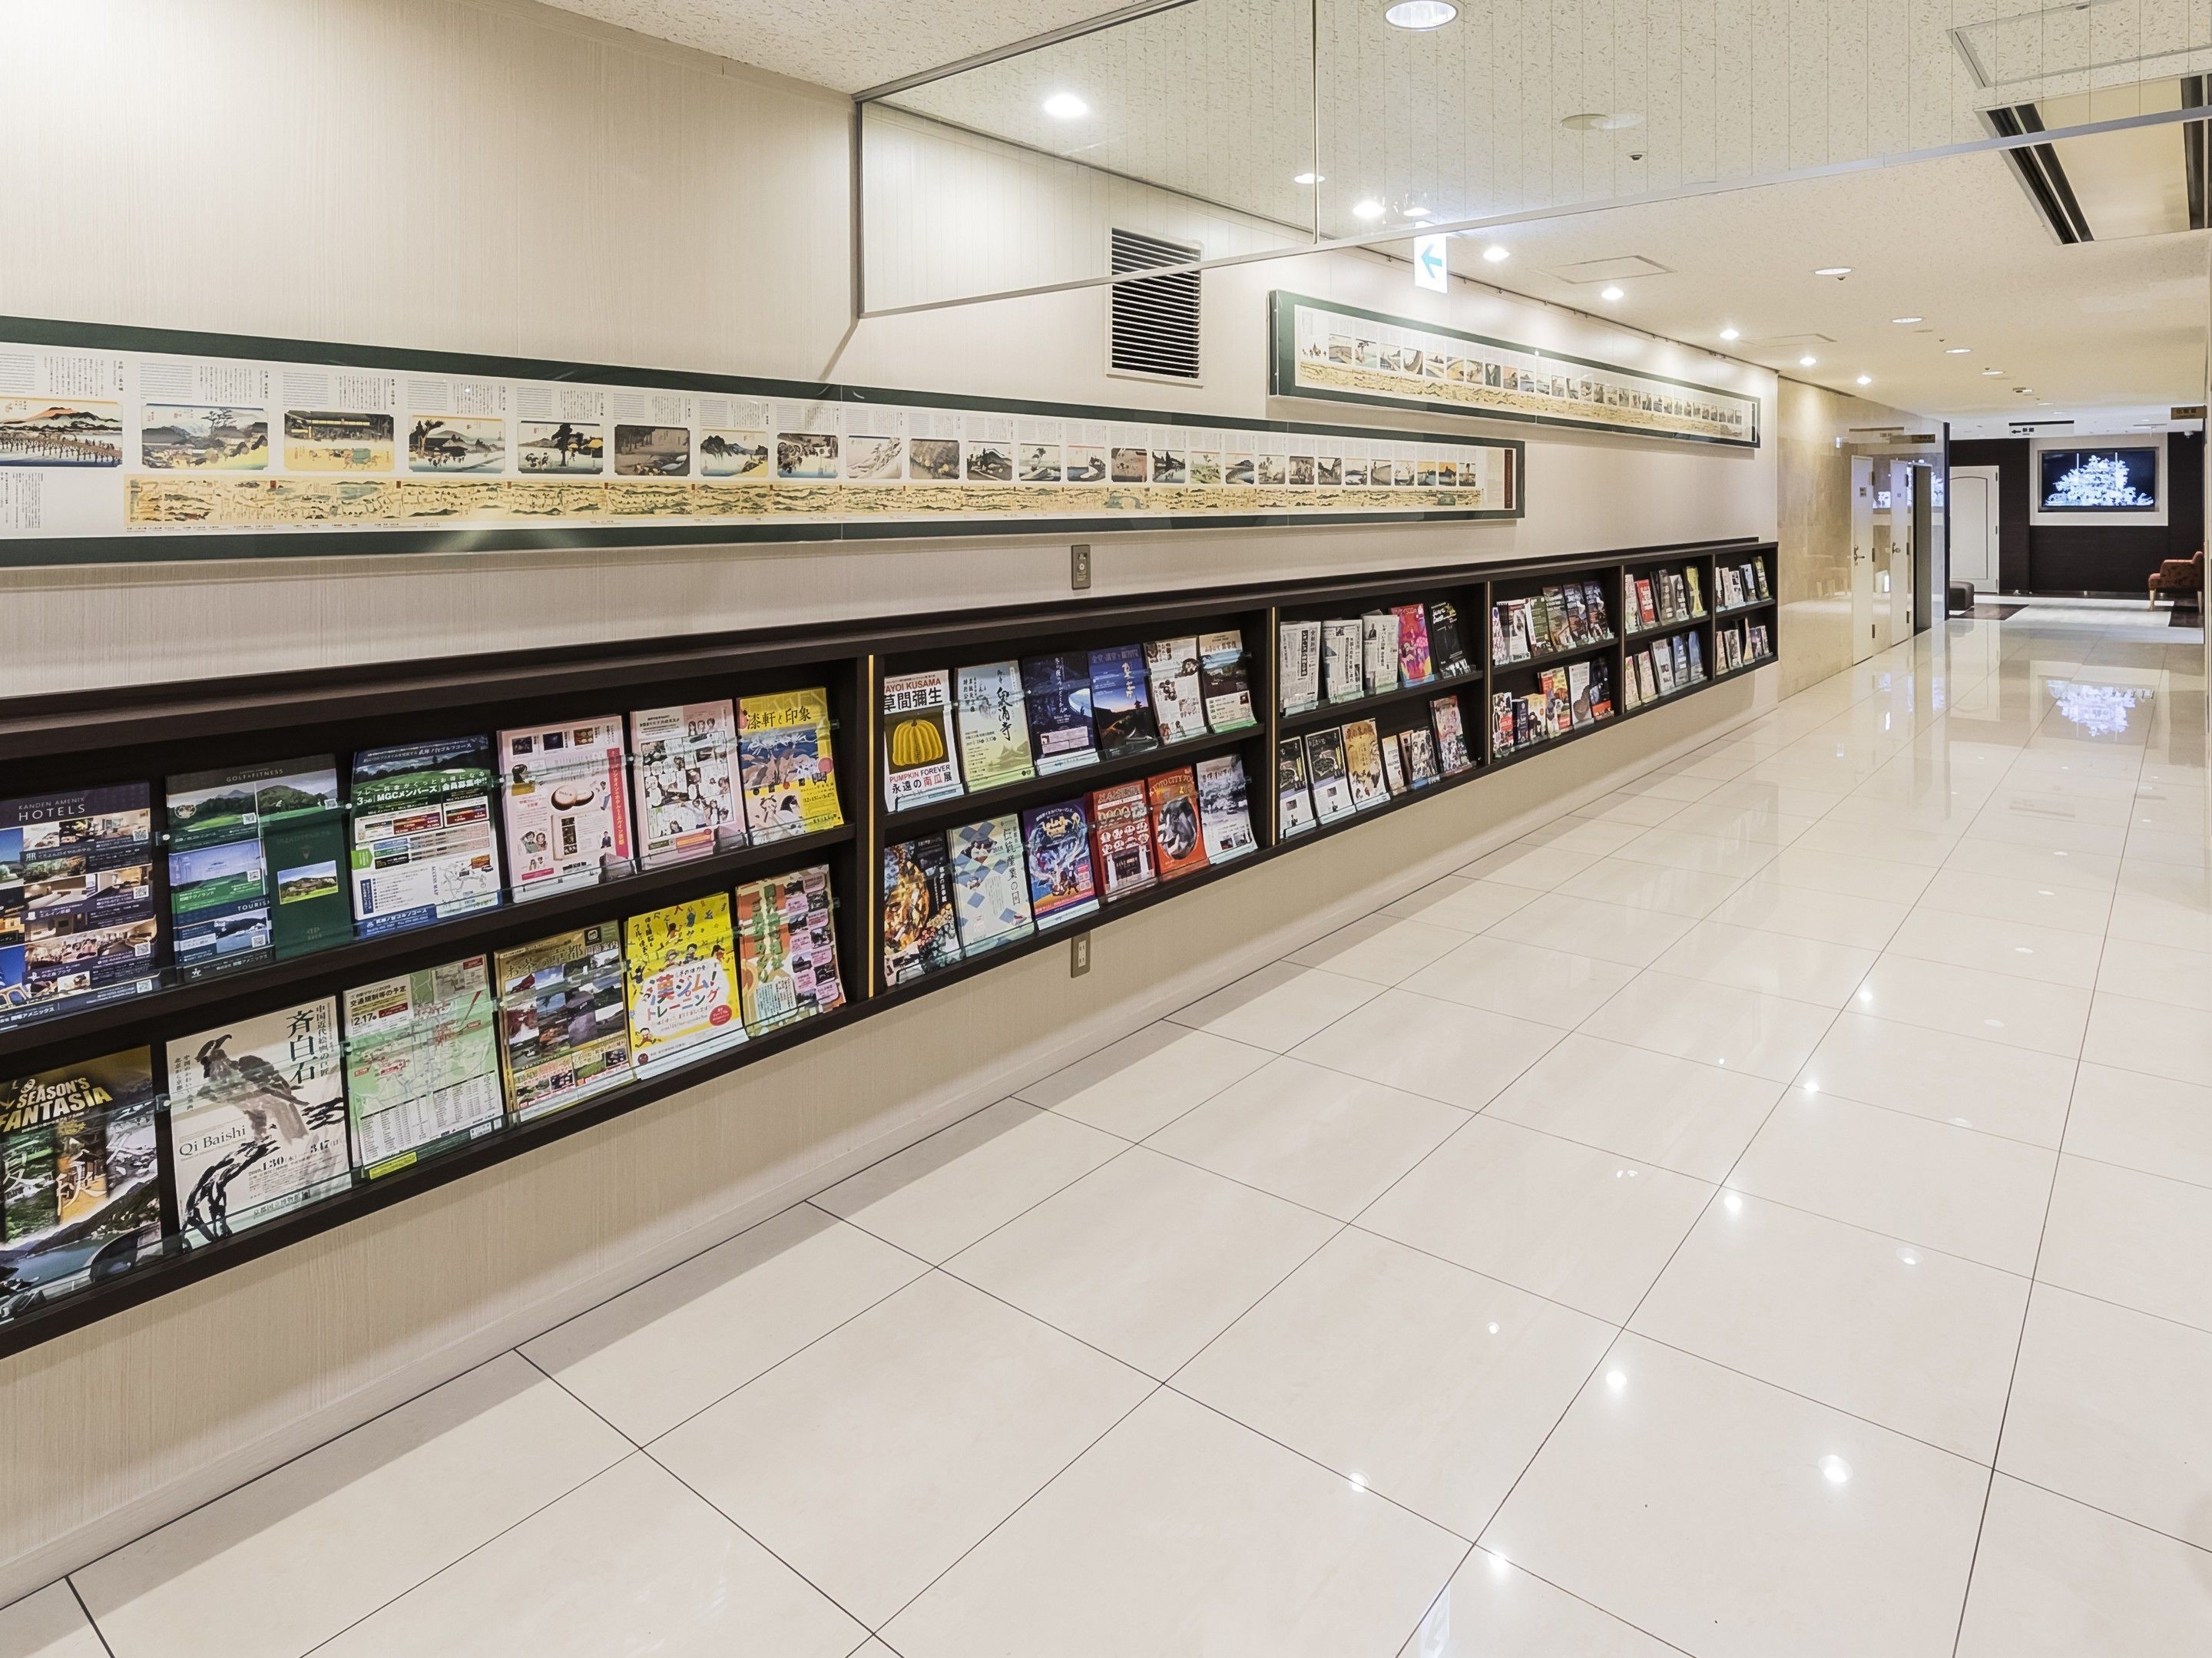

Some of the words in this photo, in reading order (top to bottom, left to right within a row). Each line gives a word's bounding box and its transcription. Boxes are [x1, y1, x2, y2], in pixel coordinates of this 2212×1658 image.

[884, 683, 905, 693] AYOI
[906, 678, 942, 690] KUSAMA
[884, 687, 943, 712] 草間彌生
[747, 706, 812, 730] 漆軒と印象
[889, 772, 919, 783] PUMPKIN
[920, 764, 951, 776] FOREVER
[892, 772, 952, 794] 永遠の南瓜展
[1168, 775, 1183, 784] CITY
[18, 802, 52, 810] KANDEN
[55, 797, 85, 806] AMENIX
[18, 804, 86, 822] HOTELS
[505, 944, 583, 978] お茶の京都
[350, 985, 406, 1008] 交通規制等の予定
[647, 987, 720, 1021] トレーニング
[353, 1013, 373, 1026] 2.17
[286, 1010, 318, 1084] 斉白石
[316, 1004, 329, 1077] 中国近代絵画の巨匠
[16, 1077, 91, 1109] SEASON'S
[179, 1140, 198, 1156] Qi
[204, 1125, 246, 1149] Baishi
